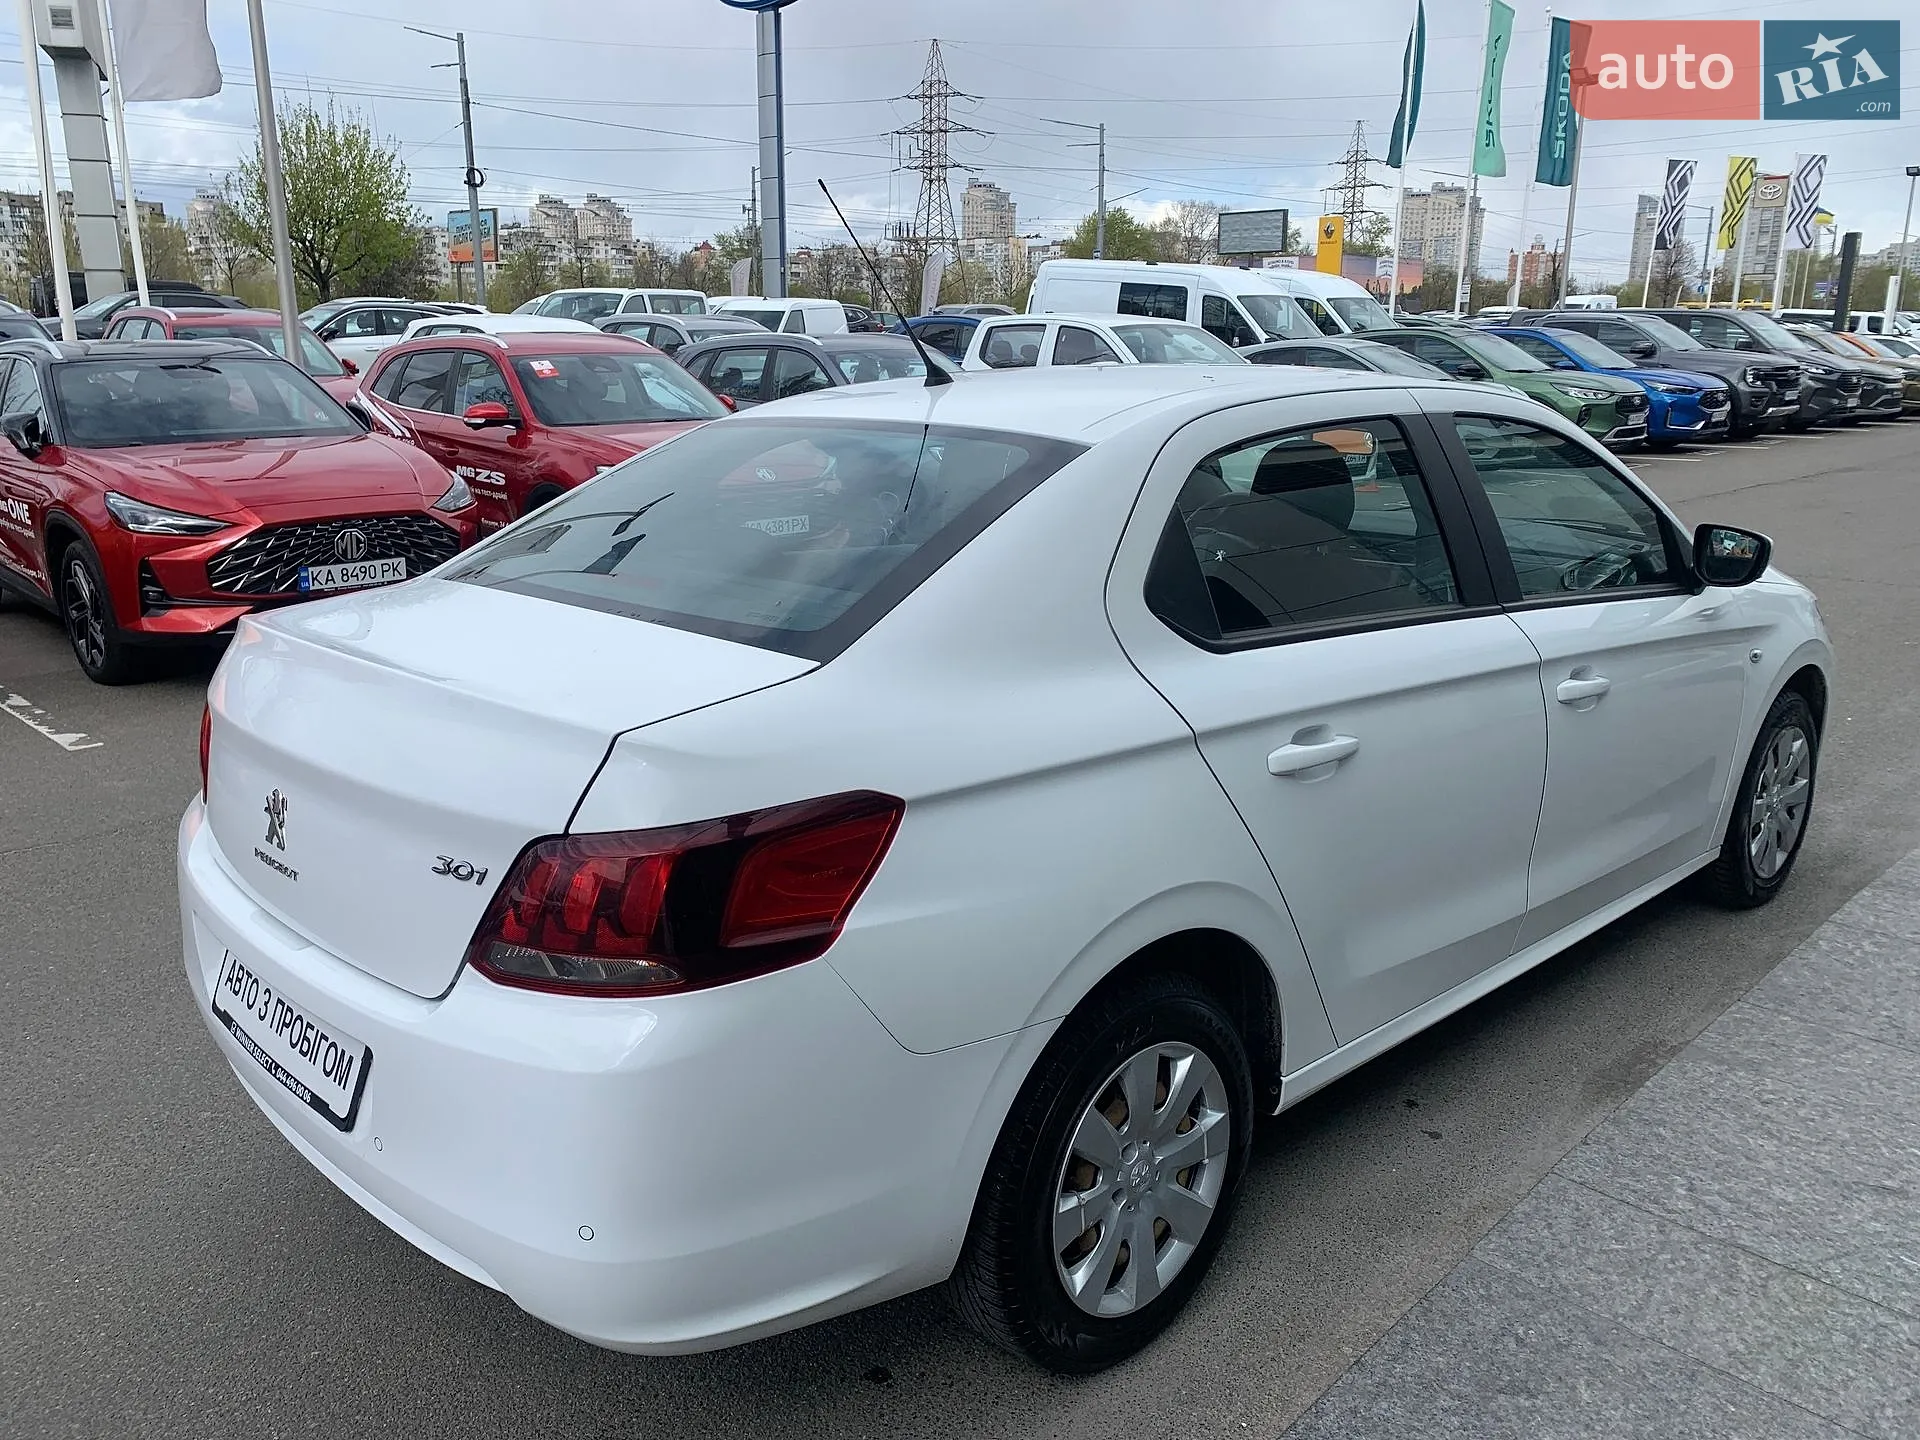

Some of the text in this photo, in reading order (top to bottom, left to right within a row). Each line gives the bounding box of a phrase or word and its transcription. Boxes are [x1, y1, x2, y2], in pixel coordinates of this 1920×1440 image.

[456, 465, 506, 486] MG ZS
[8, 498, 32, 525] ONE
[339, 531, 365, 560] MG
[310, 569, 336, 587] KA
[340, 564, 377, 583] 8490
[381, 560, 403, 579] PK
[254, 847, 299, 881] PEUGEOT
[431, 854, 488, 886] 301
[224, 959, 259, 1010] АВТО
[269, 996, 354, 1091] ПРОБІГОМ
[252, 1046, 271, 1069] SELECT
